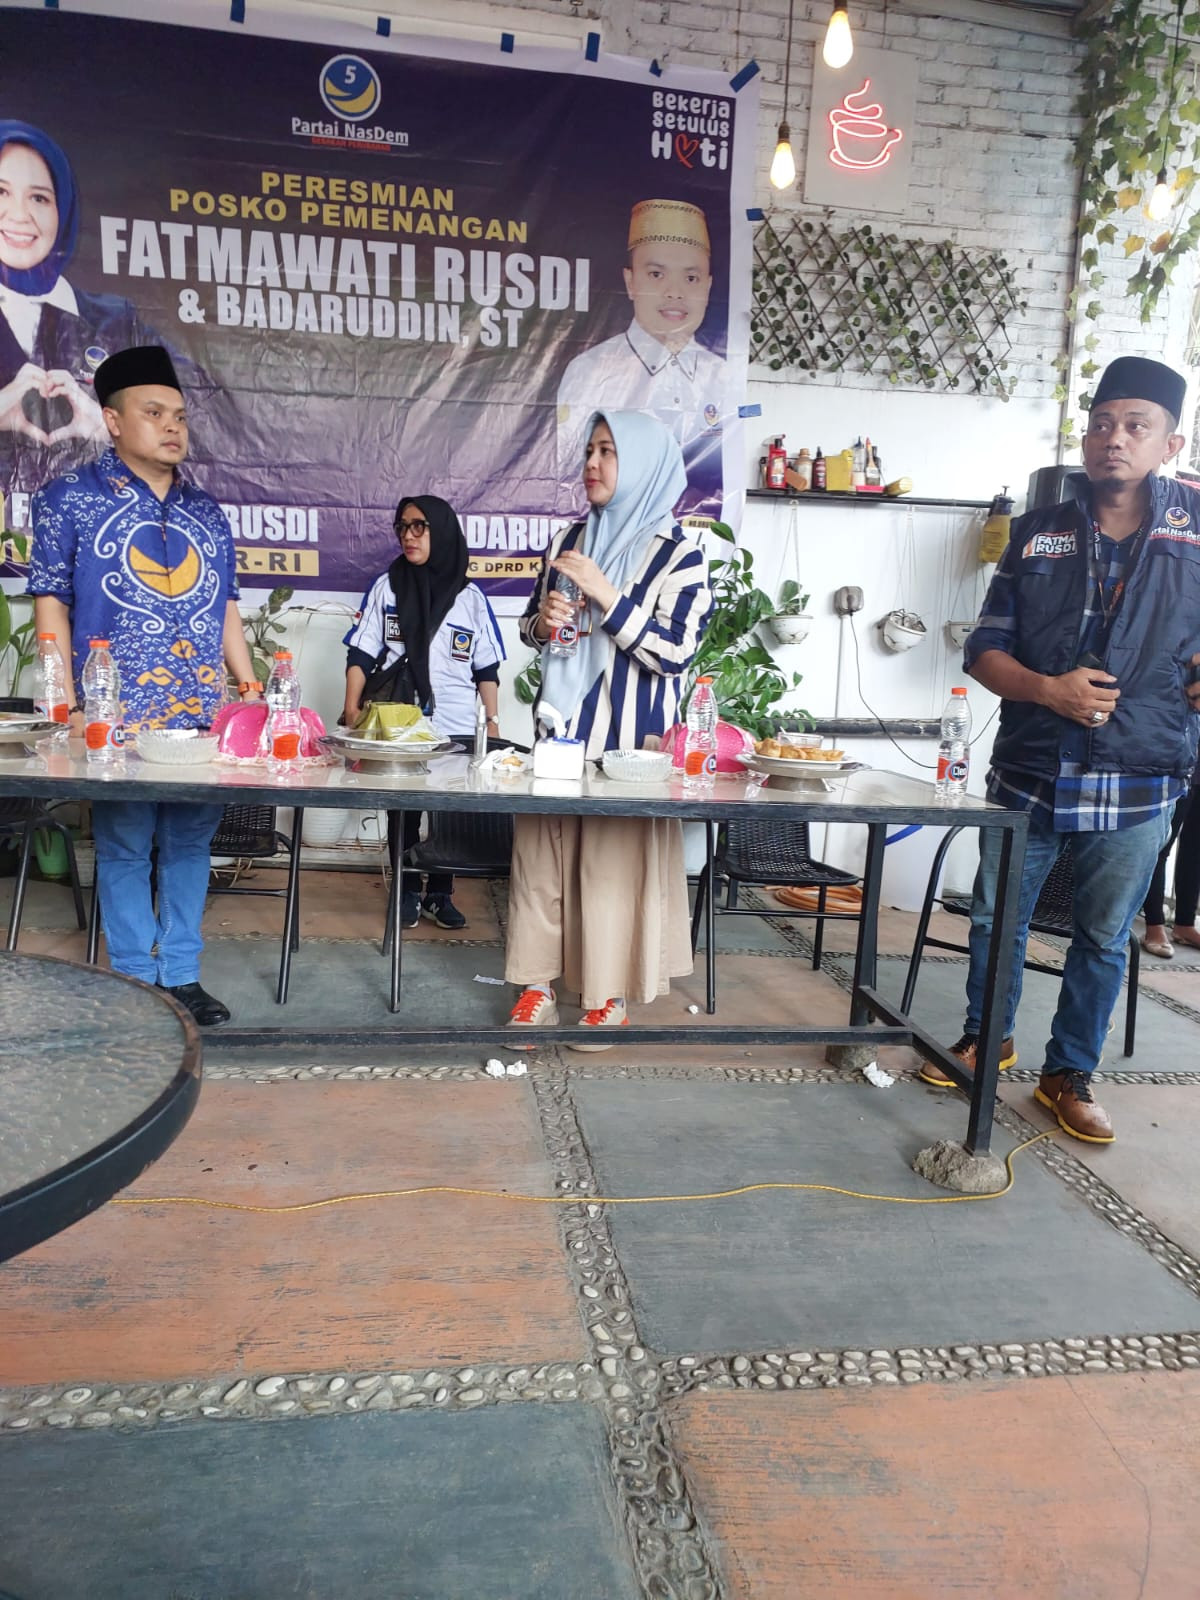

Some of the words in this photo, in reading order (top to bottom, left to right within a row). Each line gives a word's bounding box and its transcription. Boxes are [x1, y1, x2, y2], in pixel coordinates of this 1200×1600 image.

[344, 65, 357, 84] 5
[652, 91, 731, 119] Bekerja
[291, 117, 340, 137] Partai
[344, 122, 409, 145] NasDem
[261, 171, 454, 211] PERESMIAN
[170, 188, 287, 222] POSKO
[301, 201, 528, 244] PEMENANGAN
[100, 215, 416, 300] FATMAWATI
[434, 246, 590, 312] RUSDI
[178, 288, 206, 325] &
[216, 284, 470, 349] BADARUDDIN,
[479, 306, 524, 348] ST
[219, 503, 319, 542] RUSDI
[1035, 543, 1076, 554] RUSDI
[1037, 533, 1076, 546] FATMA
[485, 562, 524, 573] DPRD
